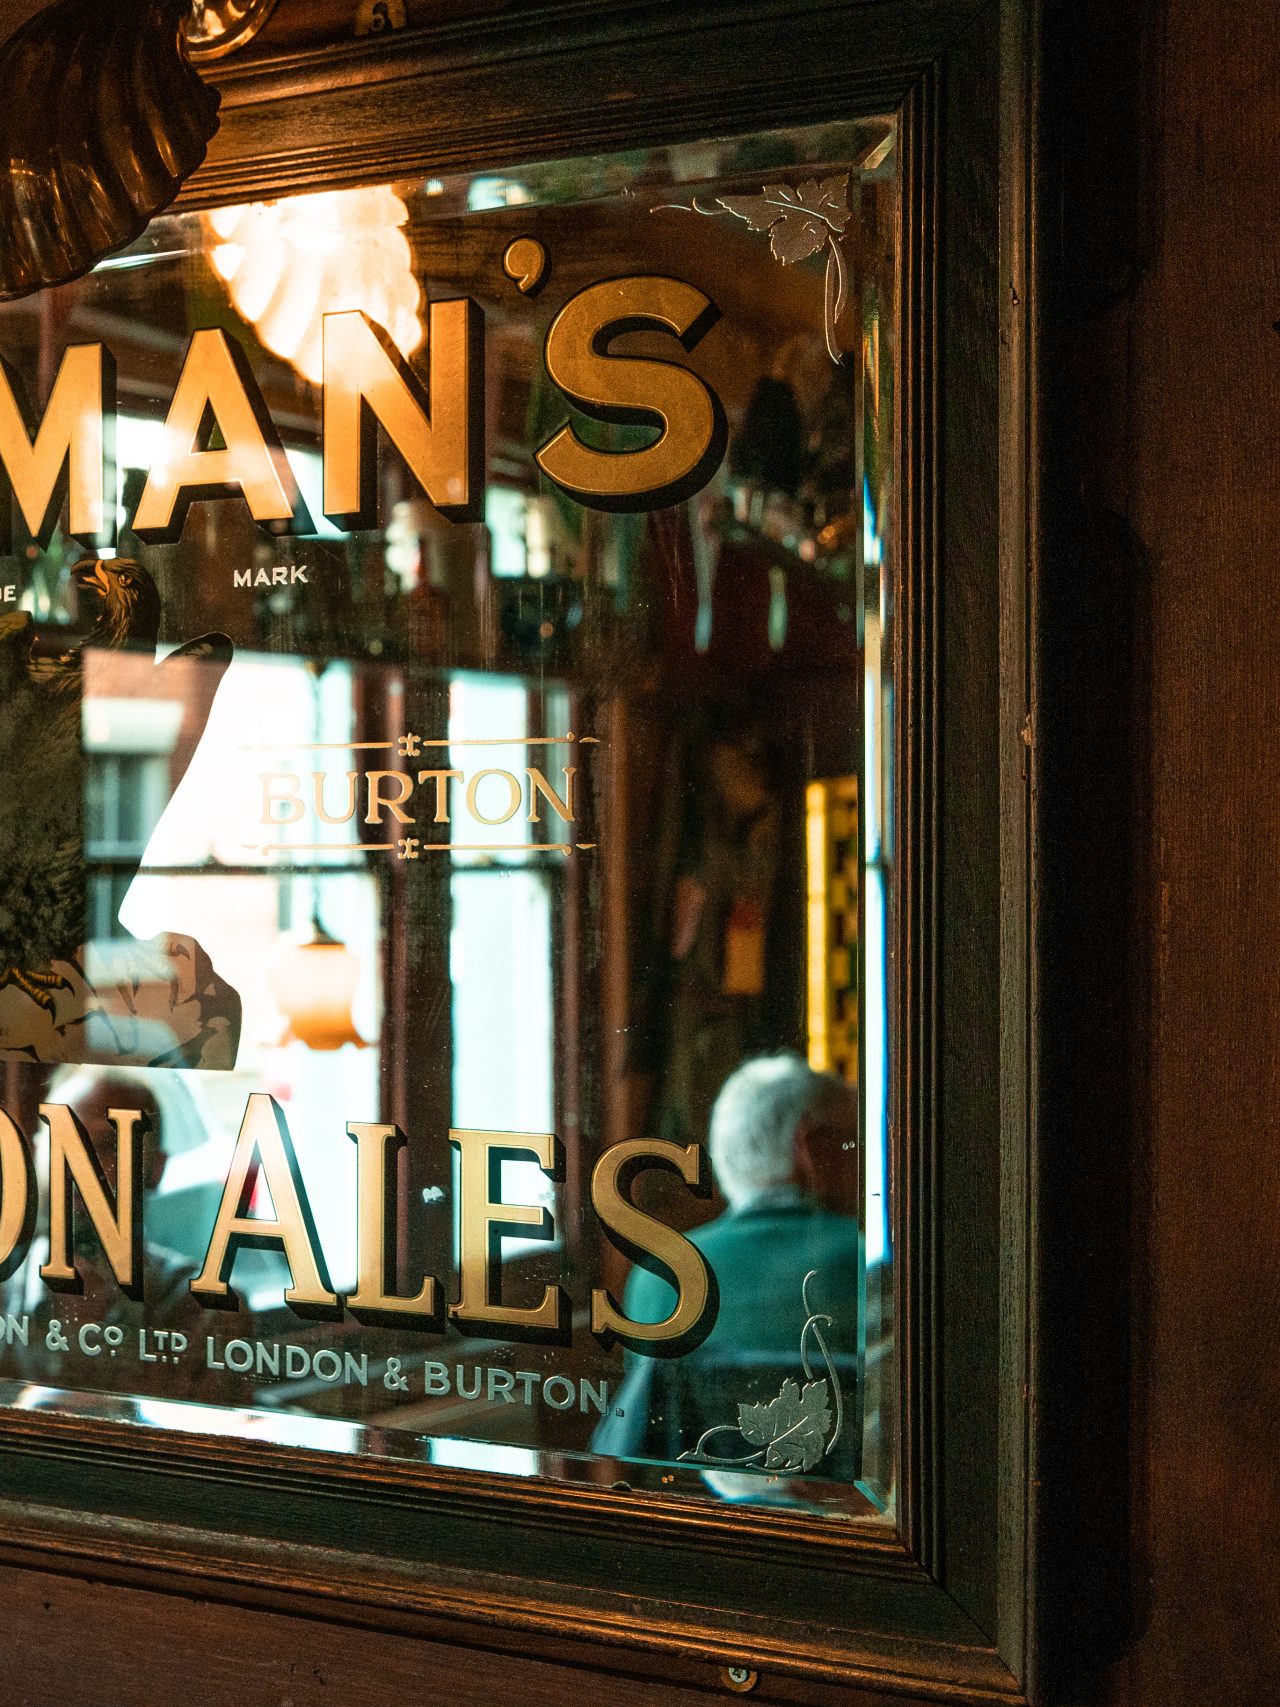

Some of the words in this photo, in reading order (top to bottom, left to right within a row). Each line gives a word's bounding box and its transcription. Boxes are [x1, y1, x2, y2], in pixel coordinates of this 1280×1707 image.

[232, 565, 310, 588] MARK
[258, 767, 577, 825] BURTON
[190, 1092, 719, 1359] ALES
[45, 1319, 70, 1351] &
[206, 1336, 369, 1386] LONDON
[383, 1357, 410, 1392] &
